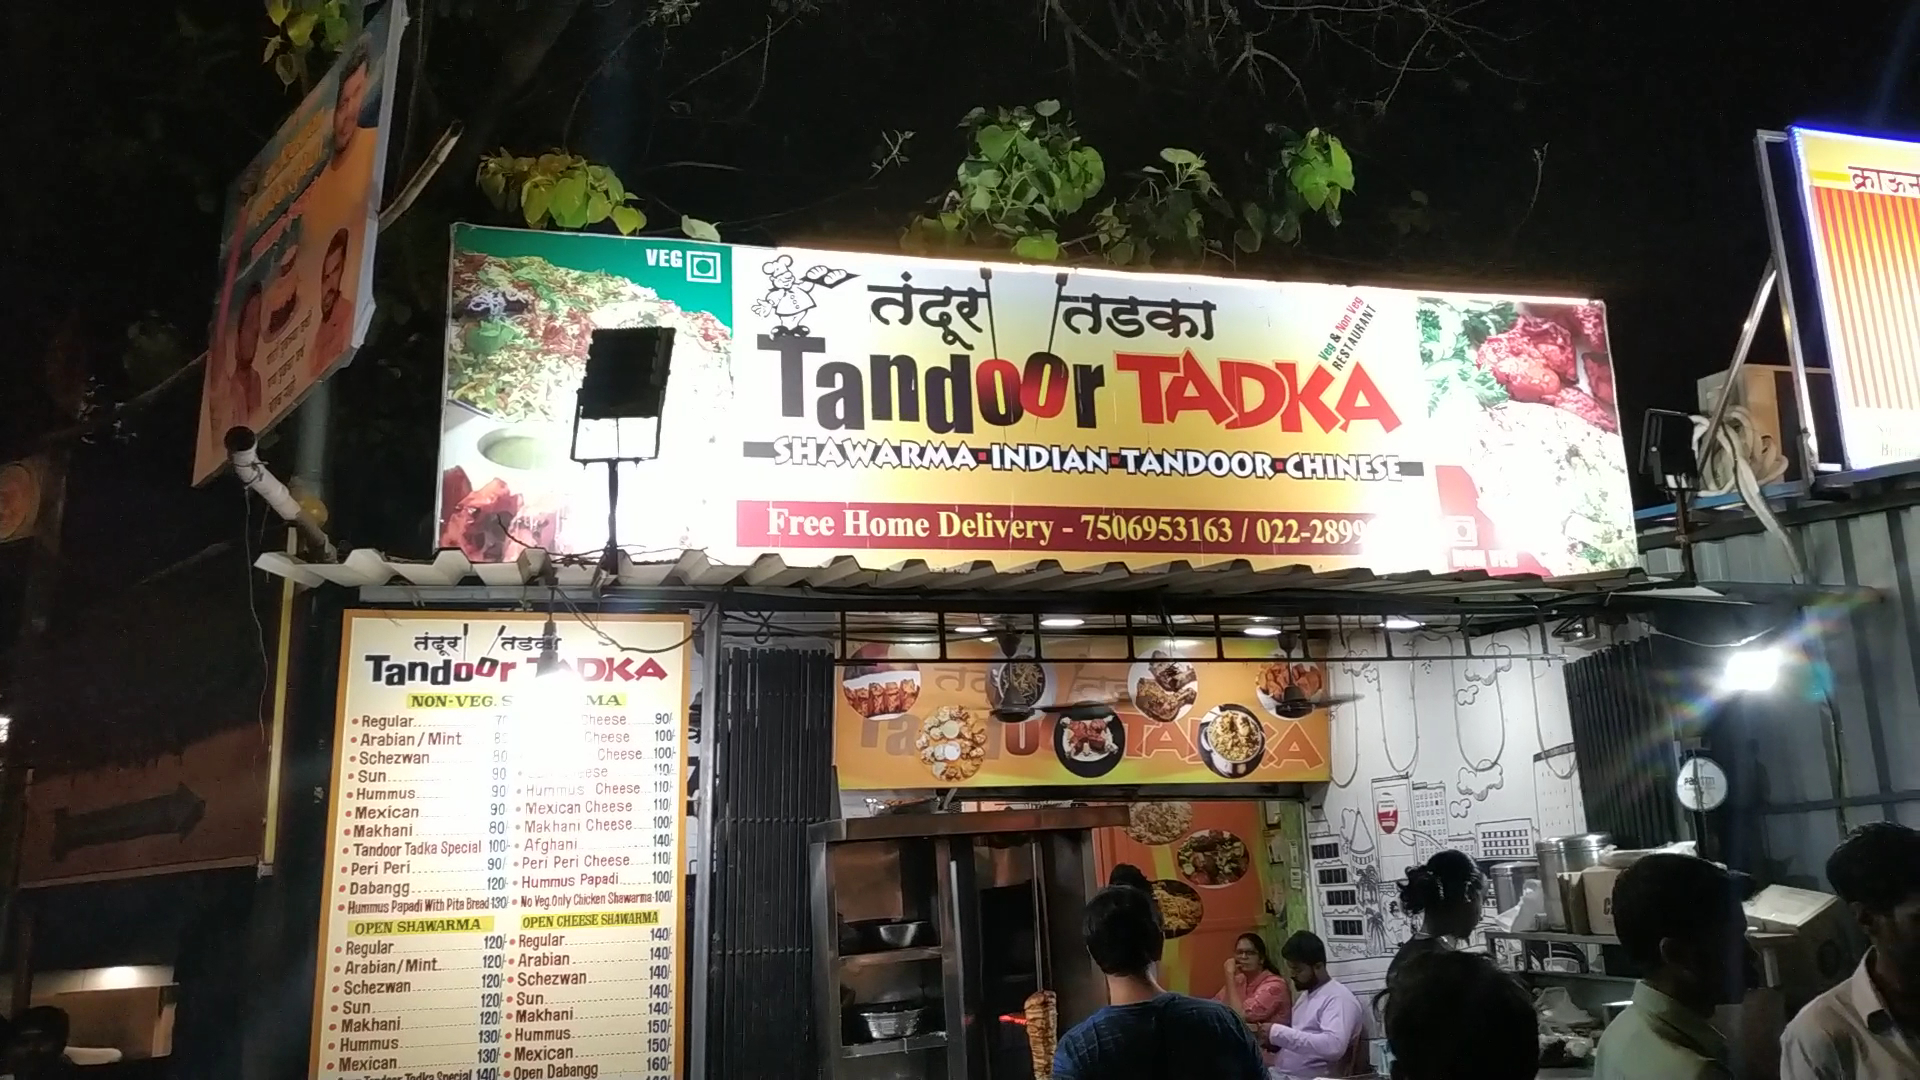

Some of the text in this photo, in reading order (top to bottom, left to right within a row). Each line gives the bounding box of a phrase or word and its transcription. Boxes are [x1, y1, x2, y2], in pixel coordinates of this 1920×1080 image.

[646, 249, 683, 268] VEG
[867, 271, 1216, 351] तंदूर तडका
[1318, 296, 1364, 361] Veg & Non Veg
[1332, 304, 1376, 371] RESTAURANT
[757, 334, 1402, 434] Tandoor TADKA
[773, 436, 1402, 482] SHAWARMA INDIAN TANDOOR CHINESE
[767, 508, 836, 538] Free
[842, 510, 931, 538] Home
[938, 511, 1055, 547] Delivery
[1081, 515, 1233, 545] 7506953163
[365, 654, 517, 686] Tandoor
[362, 714, 414, 731] Regular
[360, 733, 415, 747] Arabian
[428, 732, 462, 746] Mint
[359, 750, 430, 766] Schezwan
[598, 748, 643, 761] Cheese
[358, 769, 386, 783] Sun
[356, 787, 416, 801] Hummus
[526, 784, 585, 797] Hummus
[595, 782, 641, 795] Cheese
[354, 805, 419, 819] Mexican
[525, 803, 581, 815] Mexican
[585, 800, 633, 813] Cheese
[353, 823, 413, 838] Makhani
[524, 820, 581, 834] Makhani
[585, 818, 633, 831] Cheese
[353, 843, 402, 857] Tandoor
[405, 841, 437, 856] Tadka
[441, 840, 482, 857] Special
[523, 837, 578, 854] Afghani
[351, 861, 378, 876] Peri
[383, 860, 411, 875] Peri
[522, 855, 548, 869] Peri
[553, 854, 579, 868] Peri
[583, 854, 630, 867] Cheese
[350, 881, 411, 897] Dabangg
[521, 875, 575, 890] Hummus
[580, 872, 620, 888] Papadi
[347, 900, 390, 915] Hummus
[391, 898, 423, 915] Papadi
[424, 898, 445, 912] With
[446, 897, 465, 912] Pita
[466, 896, 489, 911] Bread
[520, 894, 533, 908] No
[573, 891, 606, 905] Chicken
[607, 890, 652, 905] Shawarma
[354, 918, 481, 935] OPEN SHAWARMA
[522, 911, 659, 929] OPEN CHEESE SHAWARMA
[346, 940, 394, 958] Regular
[518, 933, 566, 951] Regular
[517, 953, 570, 967] Arabian
[517, 971, 588, 987] Schezwan
[344, 980, 411, 996] Schezwan
[516, 991, 544, 1006] Sun
[342, 1000, 371, 1015] Sun
[515, 1006, 574, 1022] Makhani
[341, 1016, 401, 1034] Makhani
[515, 1028, 571, 1042] Hummus
[340, 1037, 399, 1053] Hummus
[514, 1046, 574, 1062] Mexican
[338, 1056, 397, 1073] Mexican
[513, 1066, 543, 1080] Open
[547, 1063, 599, 1080] Dabangg
